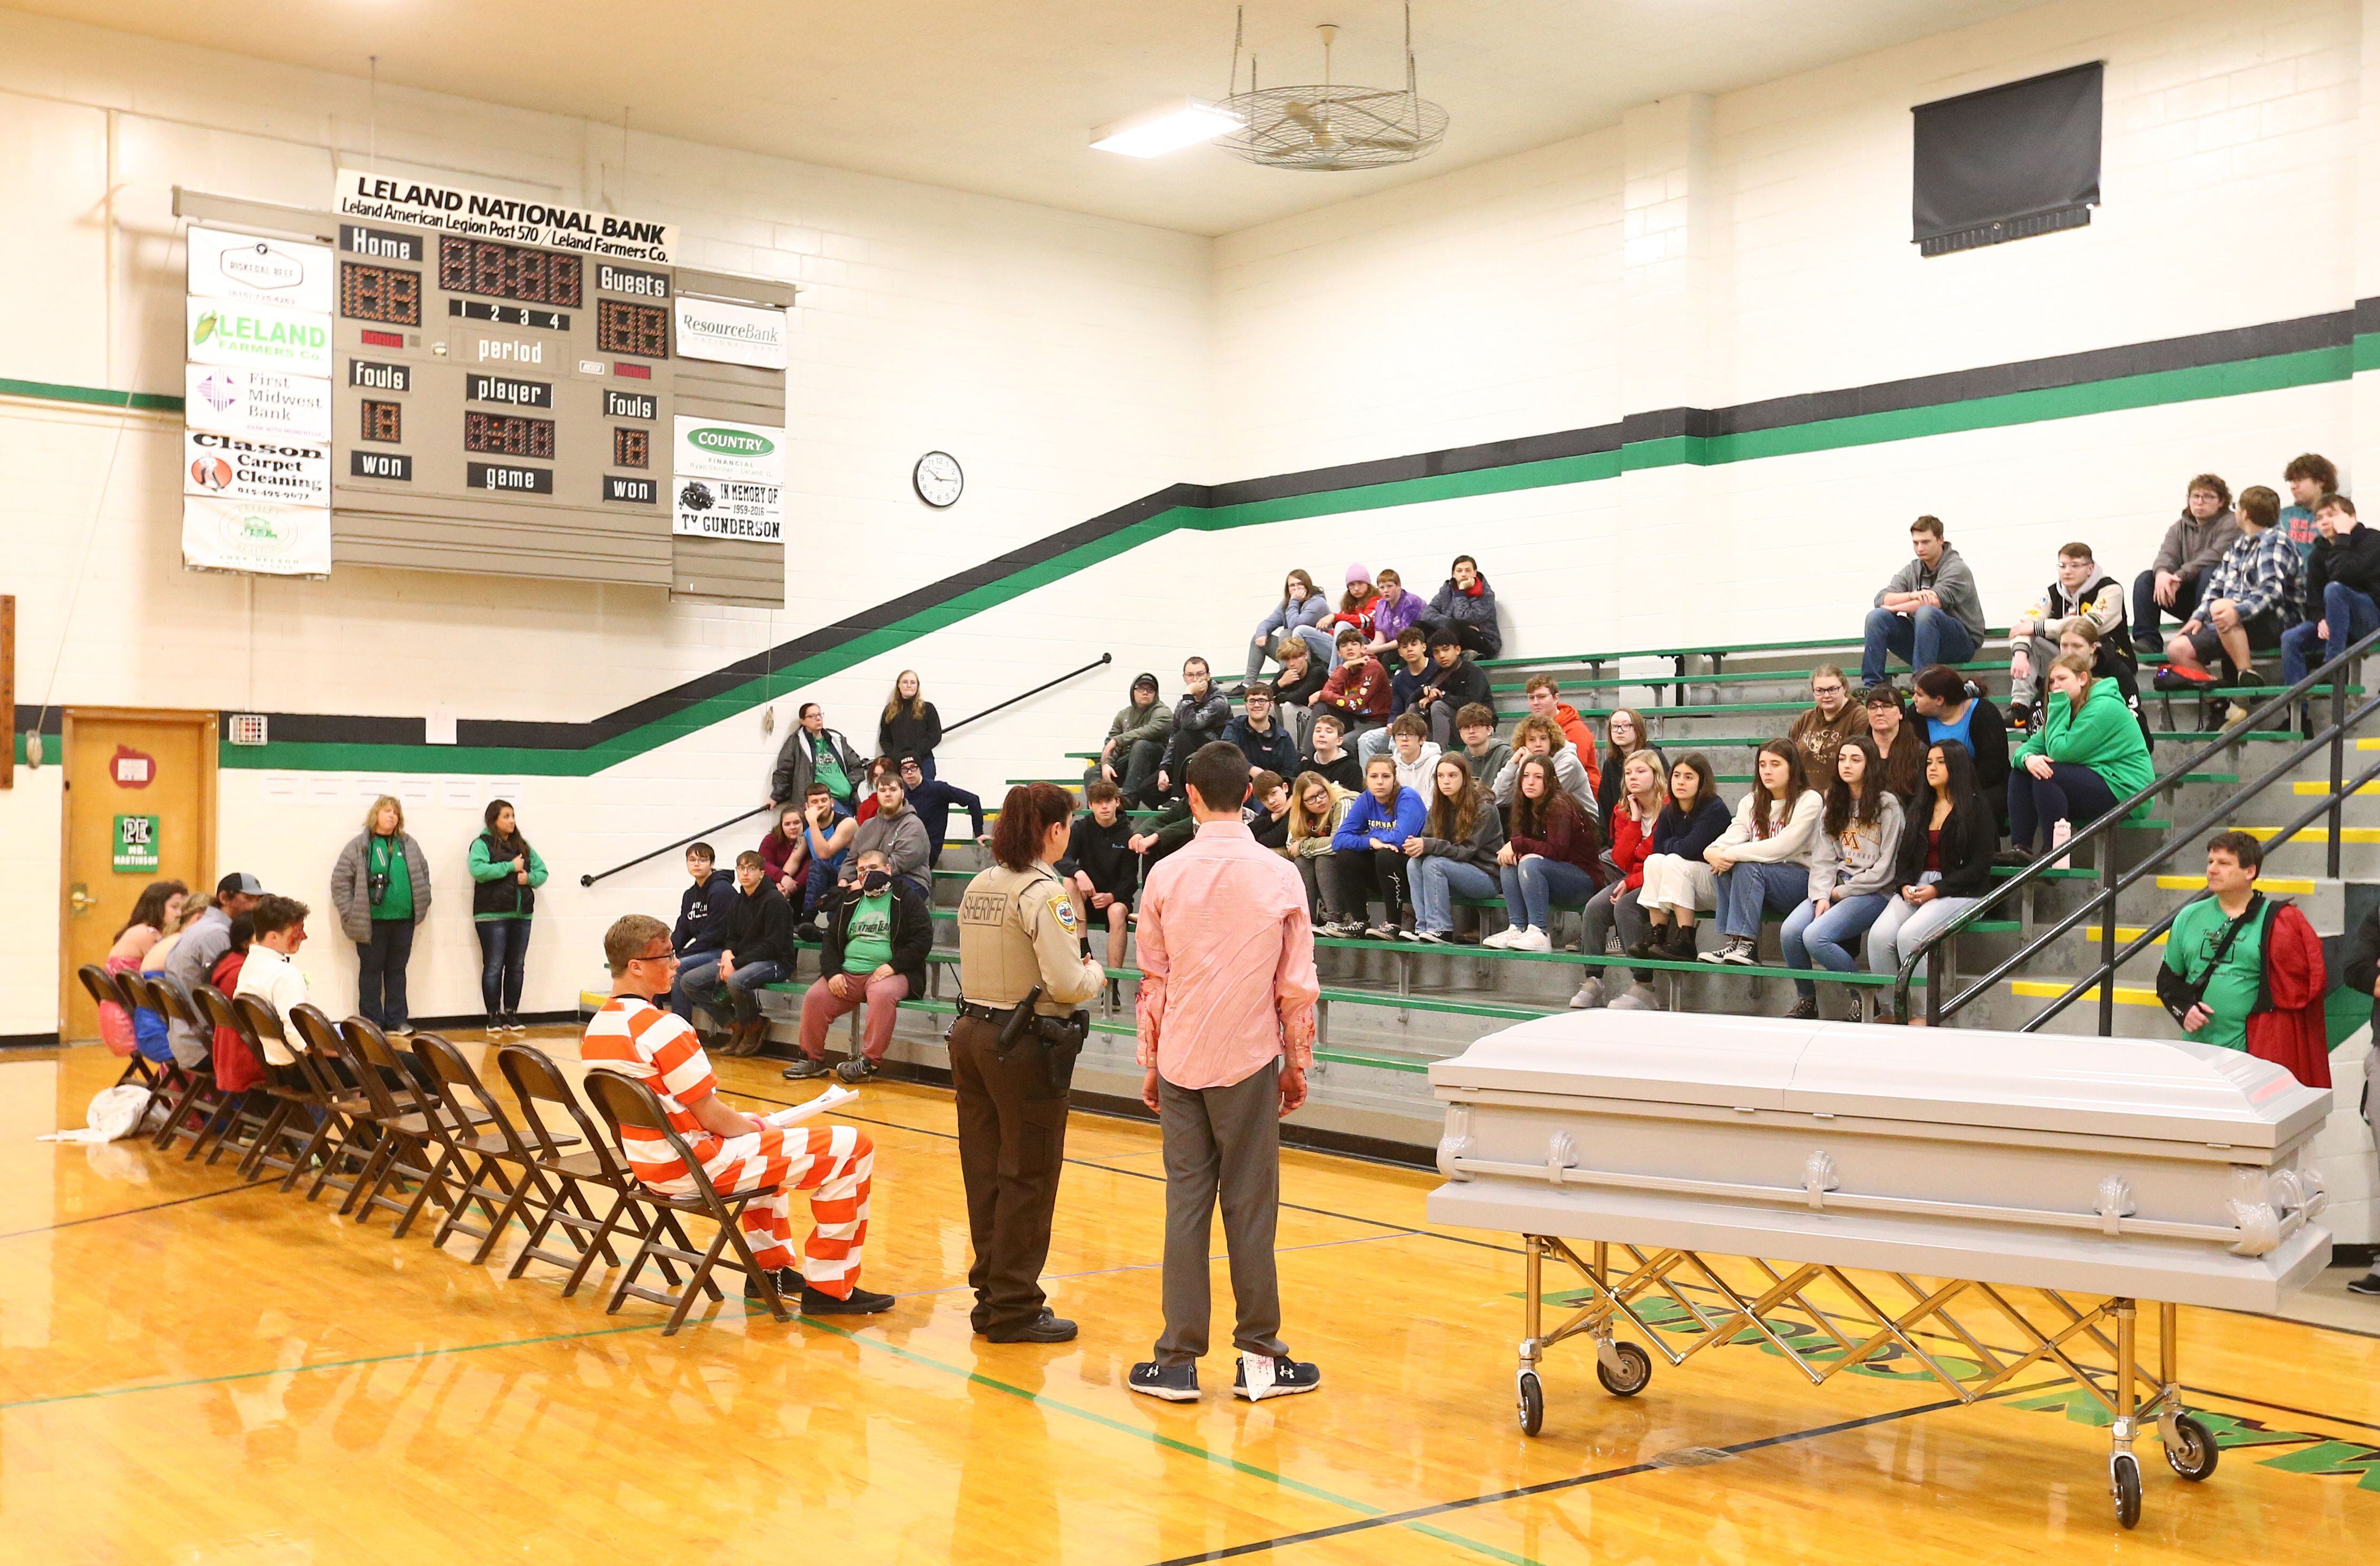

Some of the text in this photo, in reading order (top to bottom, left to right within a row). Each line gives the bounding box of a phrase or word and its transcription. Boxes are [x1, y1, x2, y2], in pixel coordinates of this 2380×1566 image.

[358, 177, 666, 245] LELAND NATIONAL BANK
[342, 197, 382, 219] Leland
[384, 206, 443, 227] American
[446, 214, 487, 235] Legion
[490, 220, 517, 239] Post
[517, 226, 539, 241] 570
[552, 231, 591, 251] Leland
[594, 239, 646, 258] Farmers
[649, 248, 668, 263] Co.
[352, 227, 410, 260] Home
[600, 266, 665, 297] Guests
[460, 302, 560, 329] 1 2 3 4
[219, 314, 326, 348] LELAND
[683, 314, 779, 342] ResourceBank
[219, 340, 324, 361] FARMERS Co.
[478, 338, 542, 364] period
[250, 373, 290, 388] First
[355, 362, 405, 390] fouls
[249, 389, 322, 408] Midwest
[477, 378, 542, 405] player
[249, 405, 291, 420] Bank
[608, 393, 652, 418] fouls
[193, 434, 325, 459] Clason
[698, 432, 764, 451] COUNTRY
[237, 454, 303, 472] Carpet
[362, 457, 403, 478] won
[690, 462, 707, 471] Ryan
[709, 465, 733, 473] Skinner
[708, 458, 754, 468] FINANCIAL
[236, 469, 322, 492] Cleaning
[486, 468, 535, 490] game
[613, 481, 649, 500] won
[720, 483, 779, 504] IN MEMORY OF
[733, 504, 765, 516] 1959-2016
[681, 514, 780, 538] TY GUNDERSON
[964, 895, 1006, 921] SHERIFF
